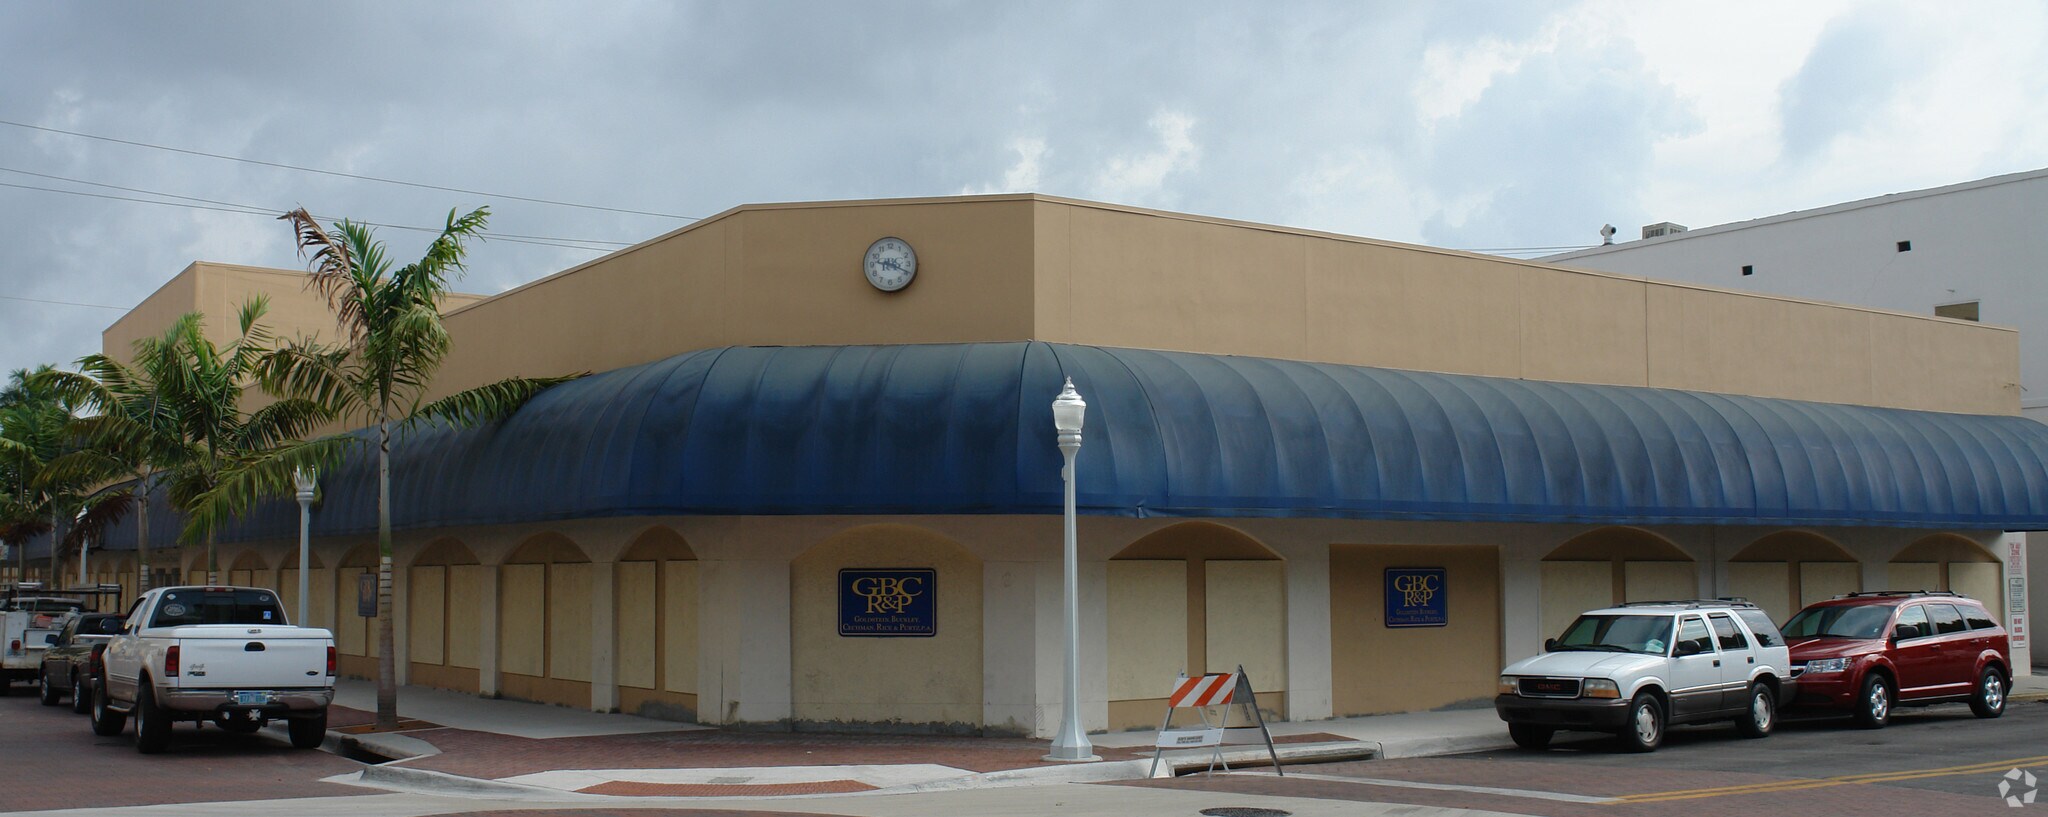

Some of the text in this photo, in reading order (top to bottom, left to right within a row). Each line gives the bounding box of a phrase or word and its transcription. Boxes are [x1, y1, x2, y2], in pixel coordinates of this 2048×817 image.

[852, 577, 923, 597] GBC
[1394, 575, 1439, 592] GBC
[865, 595, 913, 614] R&P
[1404, 590, 1433, 607] R&P
